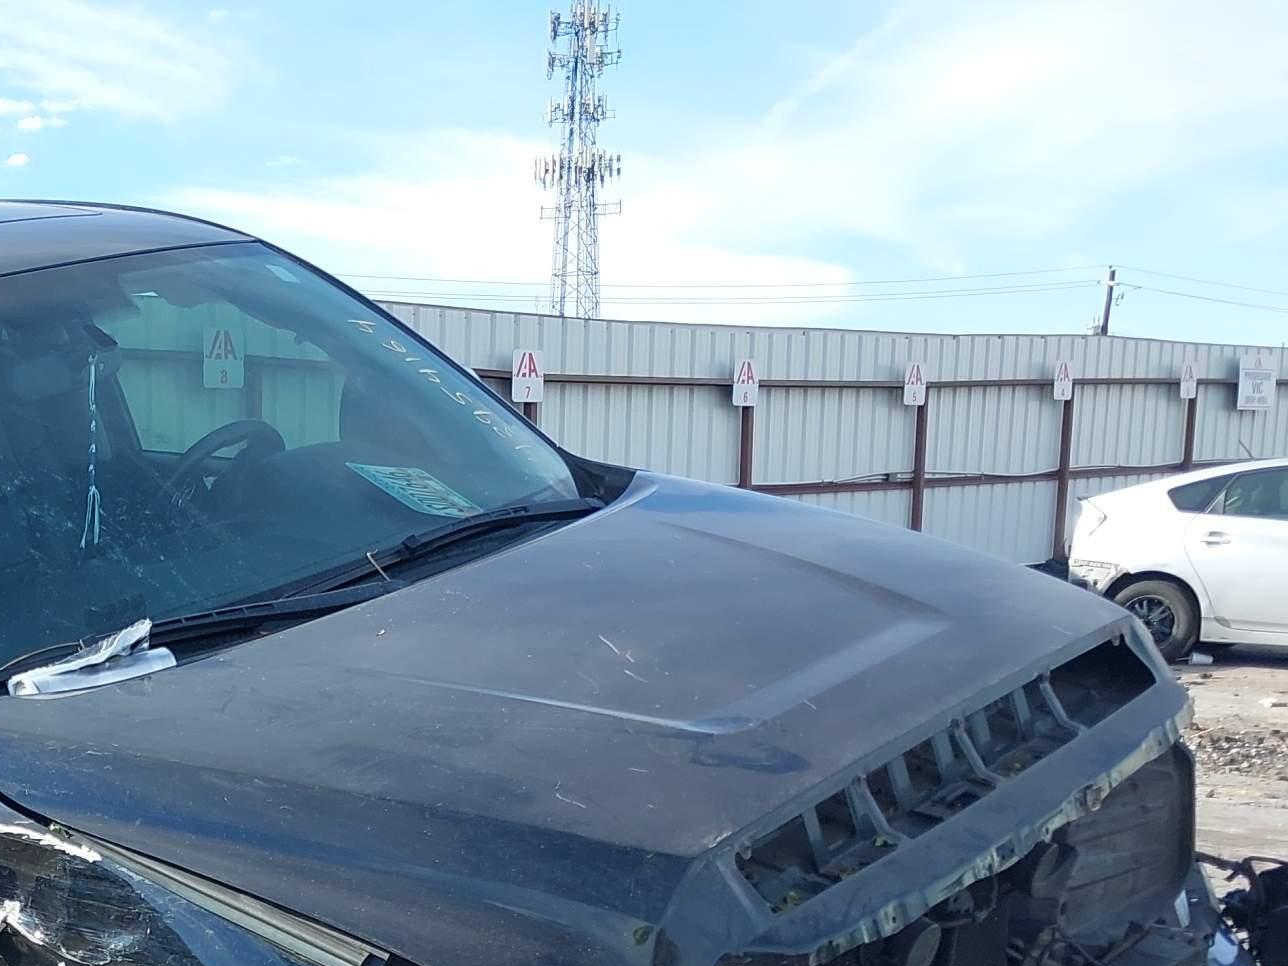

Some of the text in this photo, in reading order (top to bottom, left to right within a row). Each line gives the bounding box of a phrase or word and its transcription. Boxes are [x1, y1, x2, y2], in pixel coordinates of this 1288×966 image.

[220, 369, 228, 385] 8
[524, 386, 531, 399] 7
[743, 391, 749, 403] 6
